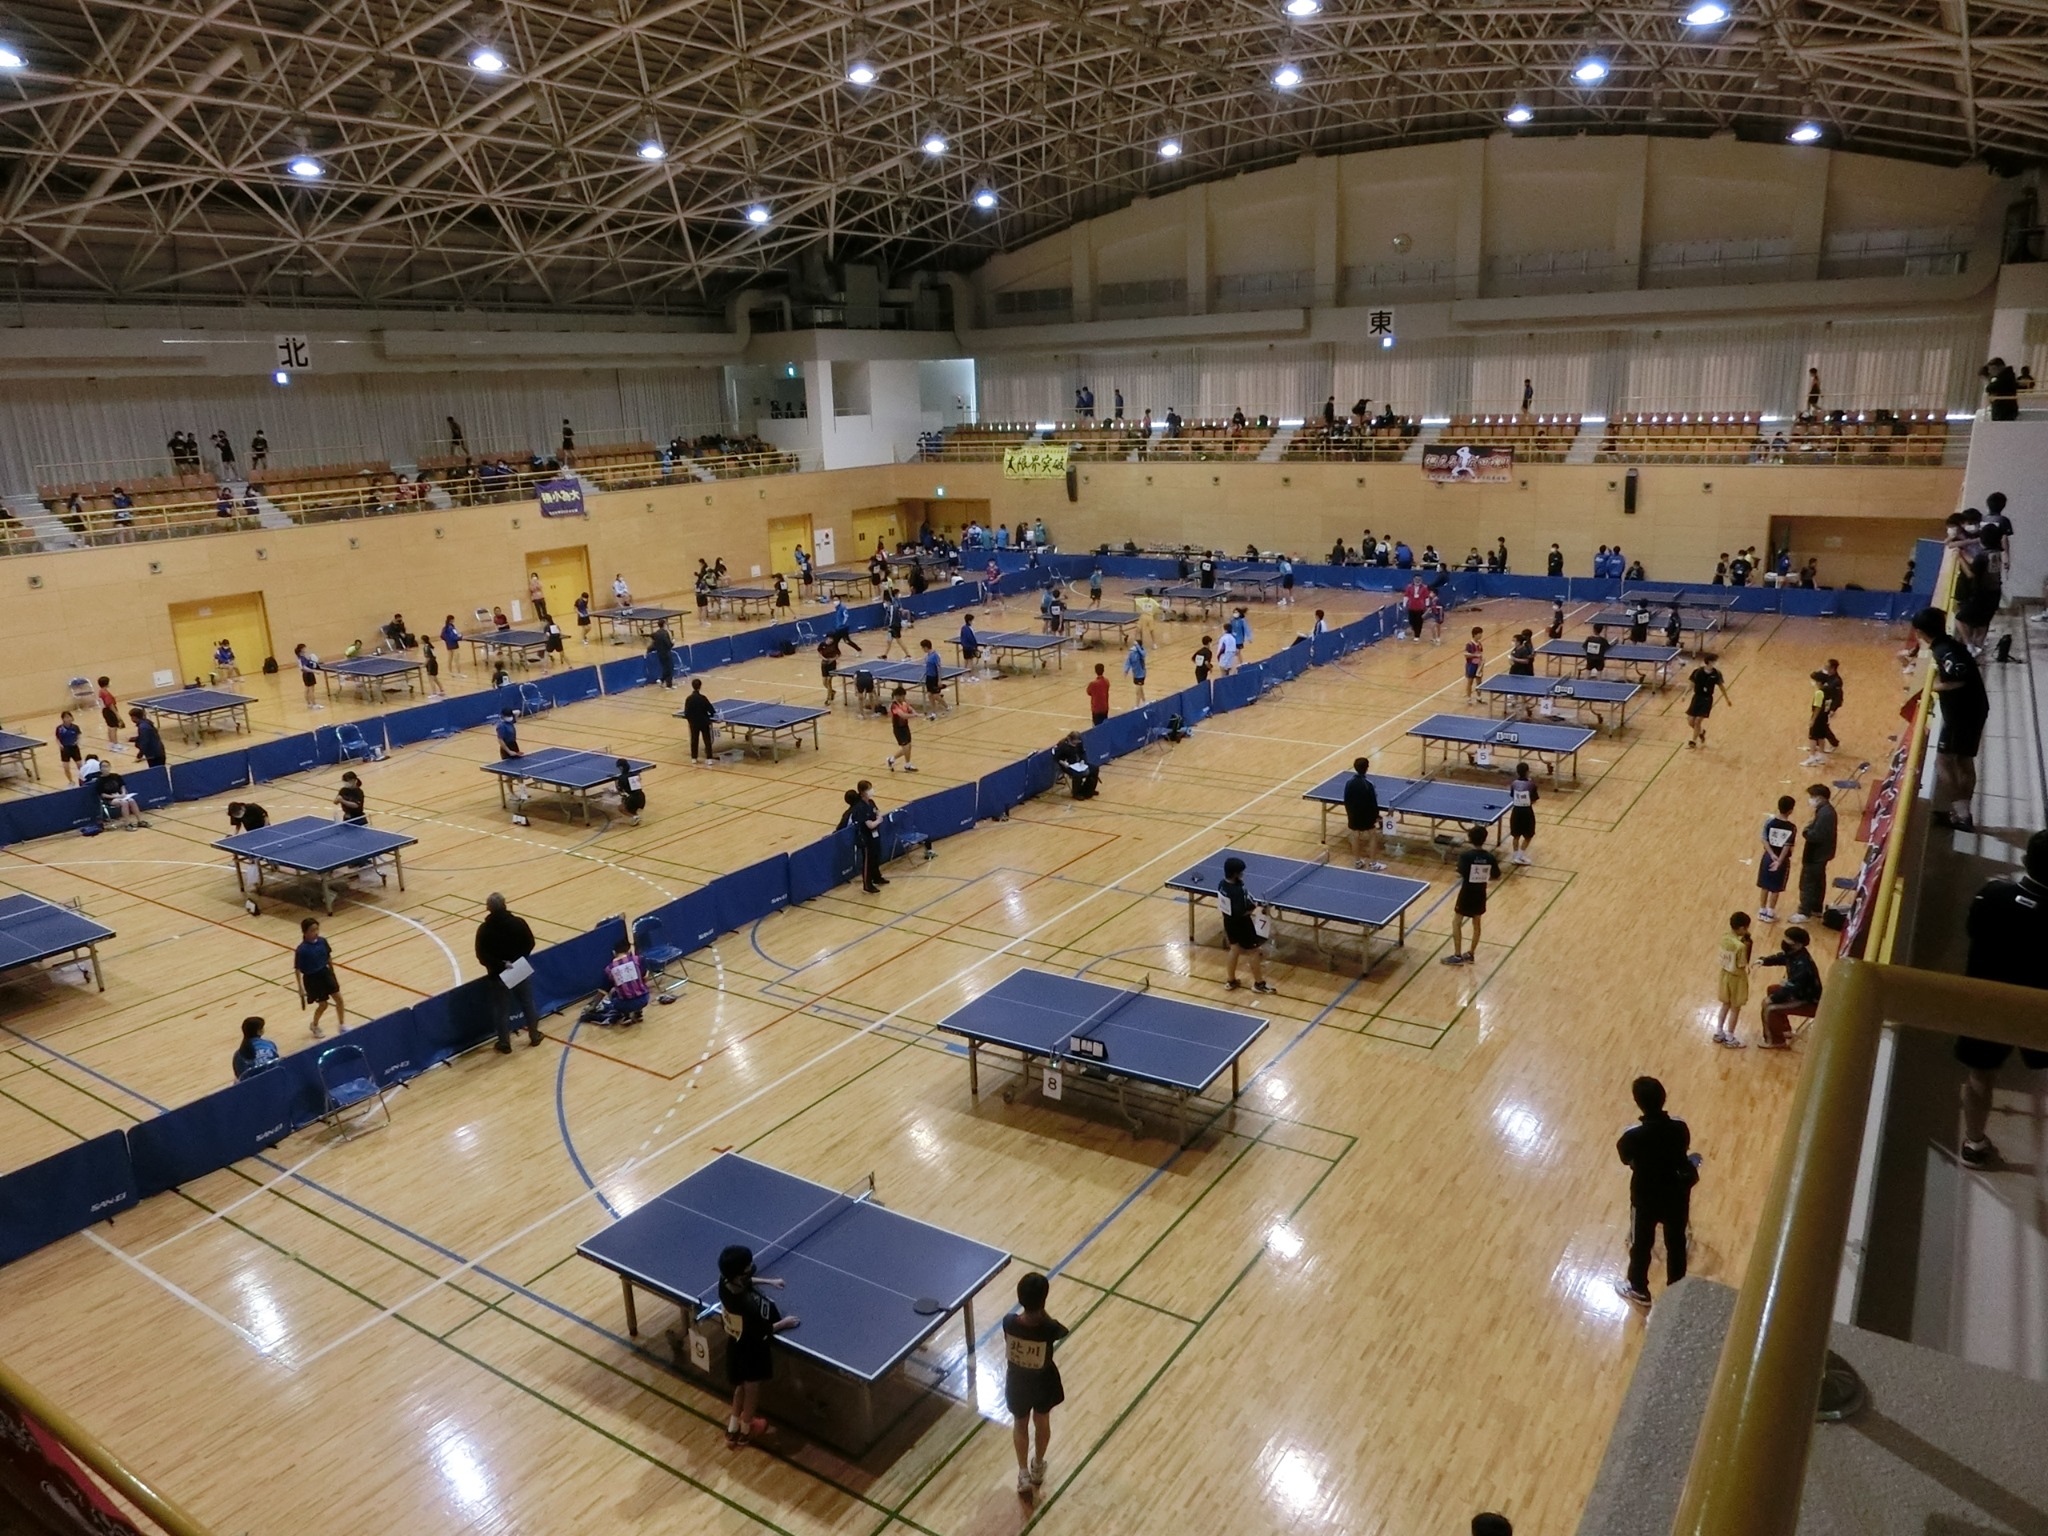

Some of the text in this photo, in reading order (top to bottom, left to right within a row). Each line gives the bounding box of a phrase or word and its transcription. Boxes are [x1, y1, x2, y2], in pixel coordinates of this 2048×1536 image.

[1370, 310, 1392, 335] 東
[279, 337, 308, 367] 北
[1480, 752, 1487, 760] 5
[1386, 821, 1394, 830] 6
[1258, 918, 1267, 930] 7
[1047, 1077, 1057, 1091] 8
[90, 1191, 127, 1212] SAN-EI
[695, 1342, 705, 1358] 9
[1010, 1340, 1041, 1357] 北川
